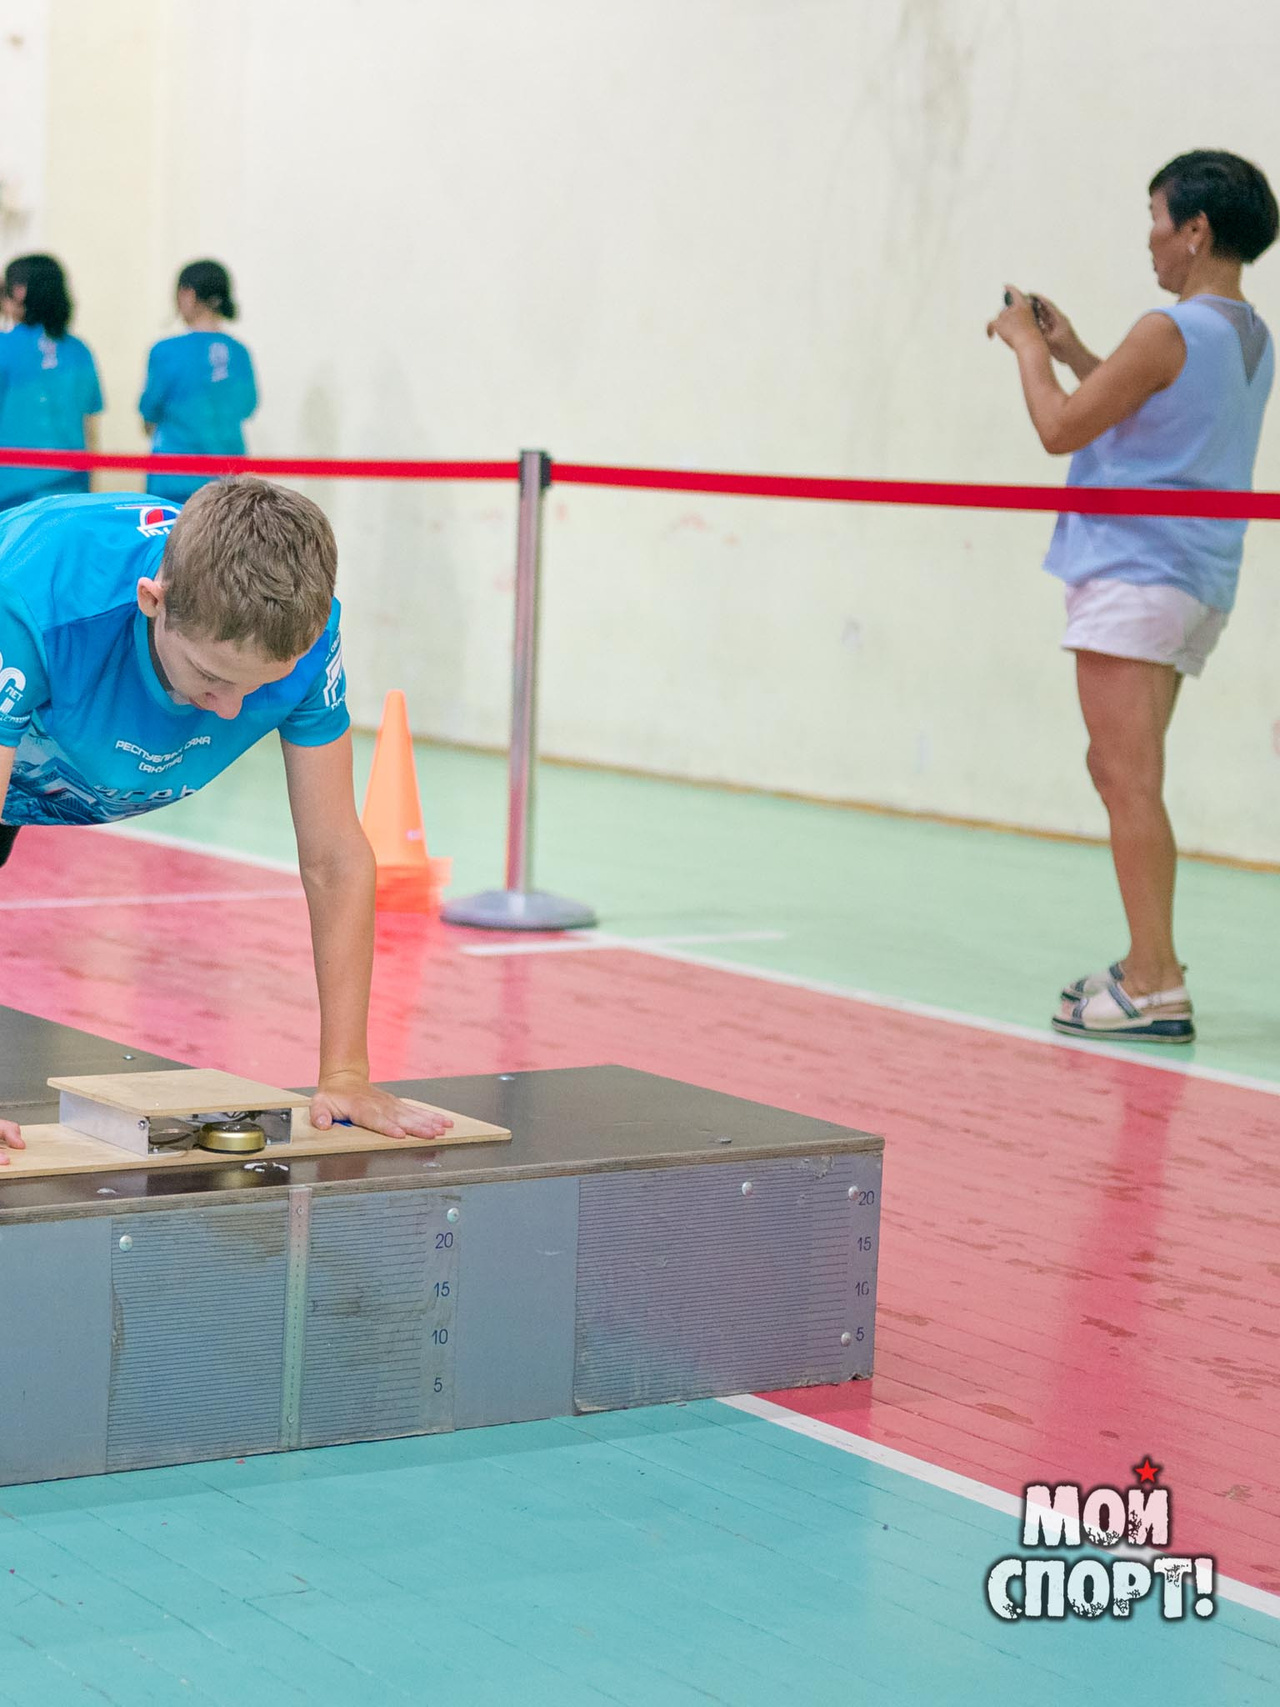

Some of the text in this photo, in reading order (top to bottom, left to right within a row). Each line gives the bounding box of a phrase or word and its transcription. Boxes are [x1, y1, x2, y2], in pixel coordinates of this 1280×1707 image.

[5, 686, 24, 702] ЛЕТ
[858, 1190, 875, 1206] 20
[435, 1232, 454, 1249] 20
[856, 1236, 872, 1252] 15
[433, 1281, 451, 1298] 15
[431, 1328, 449, 1345] 10
[855, 1326, 865, 1342] 5
[433, 1377, 443, 1393] 5
